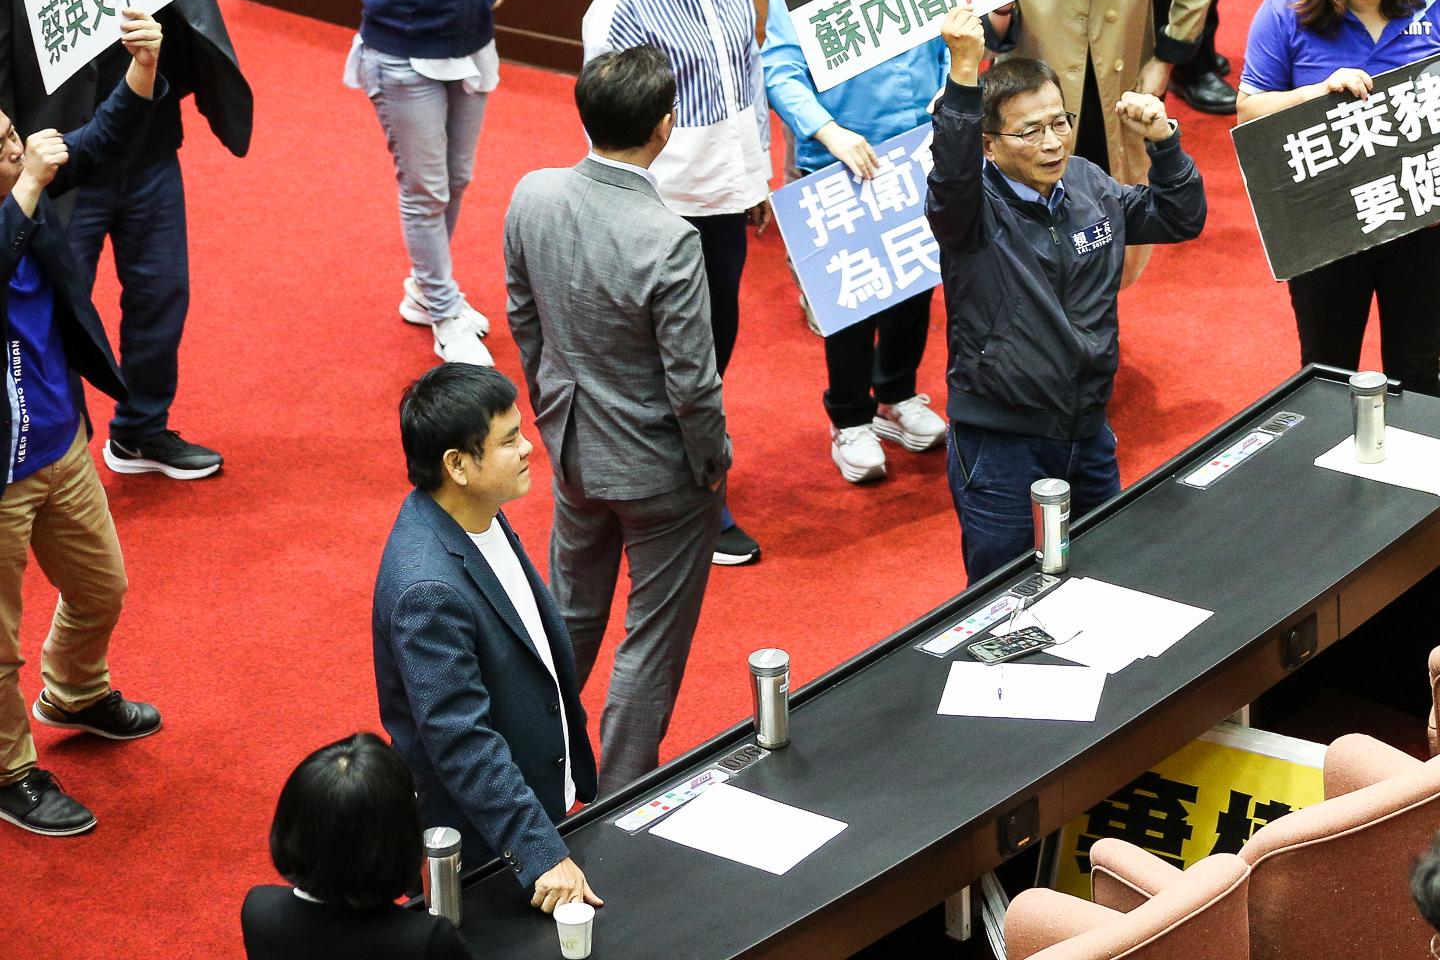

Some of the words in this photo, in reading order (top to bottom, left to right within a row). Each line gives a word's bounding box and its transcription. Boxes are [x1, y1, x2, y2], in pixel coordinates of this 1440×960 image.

[825, 215, 942, 310] 為民
[12, 340, 22, 385] TAIWAN
[17, 387, 30, 432] MOVING
[17, 436, 27, 463] KEEP
